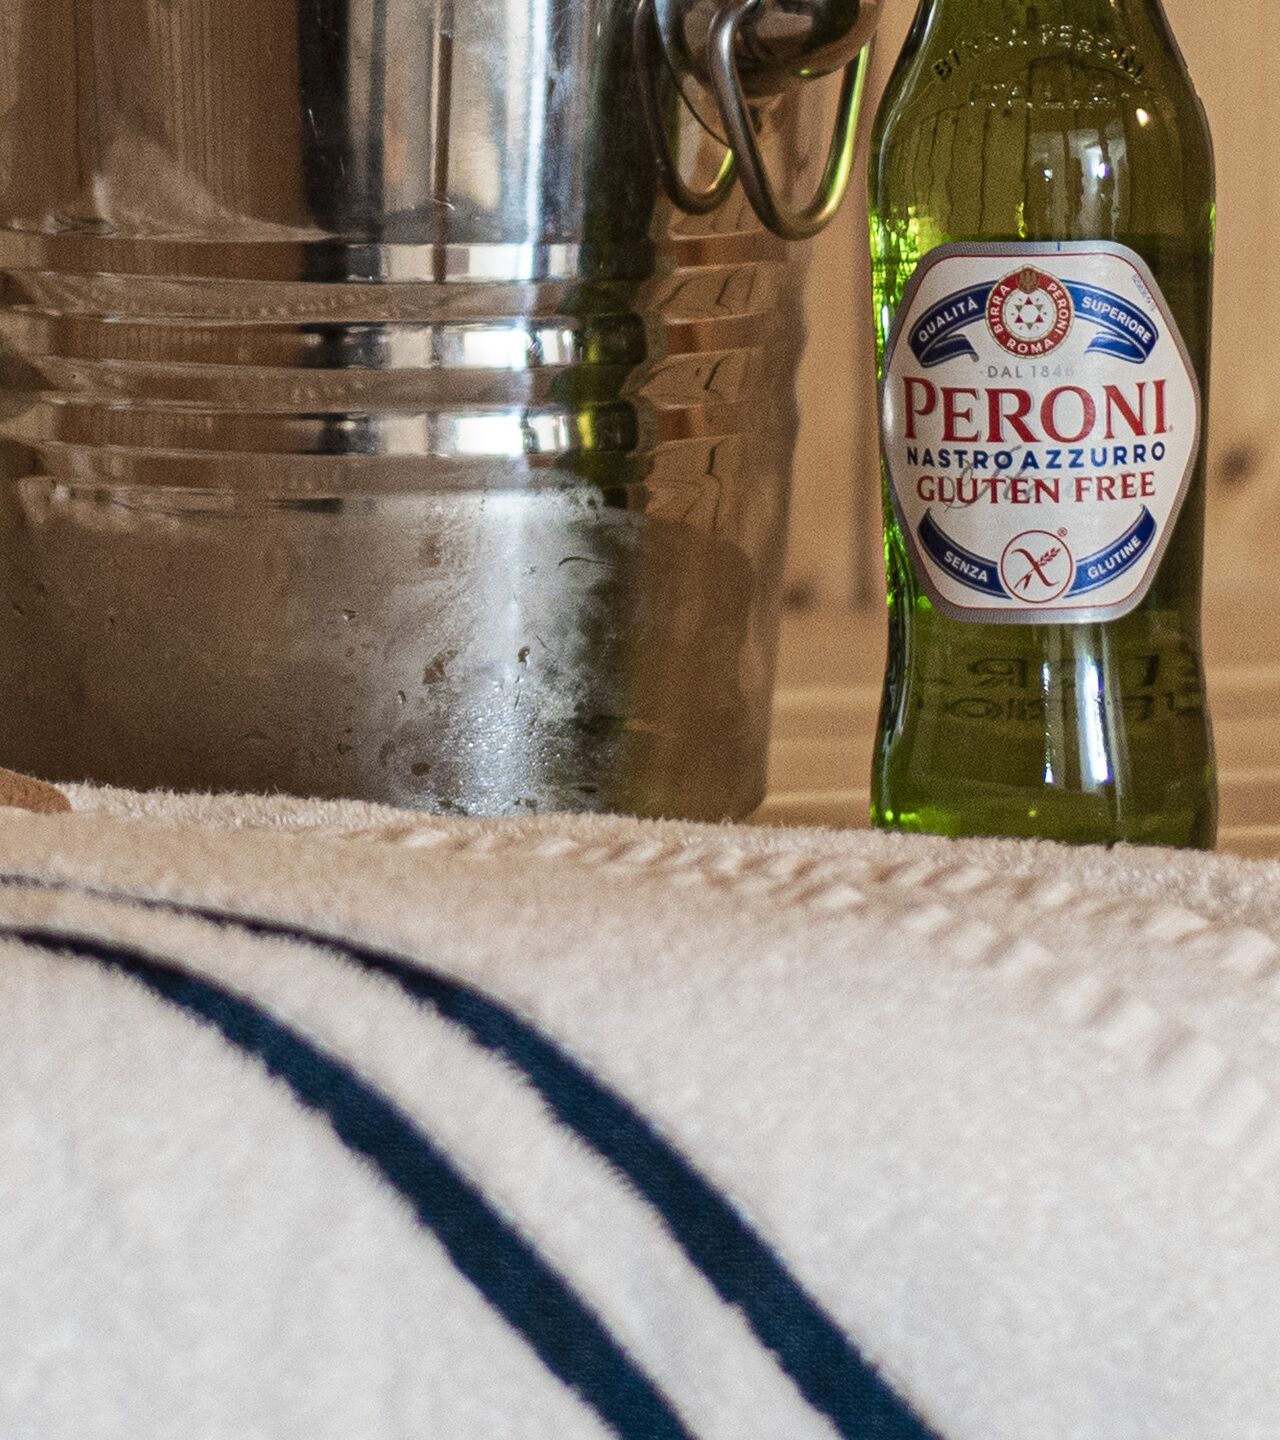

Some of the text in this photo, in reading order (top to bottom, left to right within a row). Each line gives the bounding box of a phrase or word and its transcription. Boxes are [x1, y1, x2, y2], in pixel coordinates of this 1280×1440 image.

[919, 295, 1152, 343] QUALITÀ SUPERIORE
[990, 284, 1011, 334] BIRRA
[1046, 281, 1069, 335] PERONI
[1006, 338, 1055, 354] ROMA
[987, 365, 1024, 378] DAL
[902, 376, 1168, 444] PERONI
[917, 474, 1060, 504] GLUTEN
[1074, 471, 1156, 503] FREE
[943, 534, 1141, 583] SENZA GLUTINE
